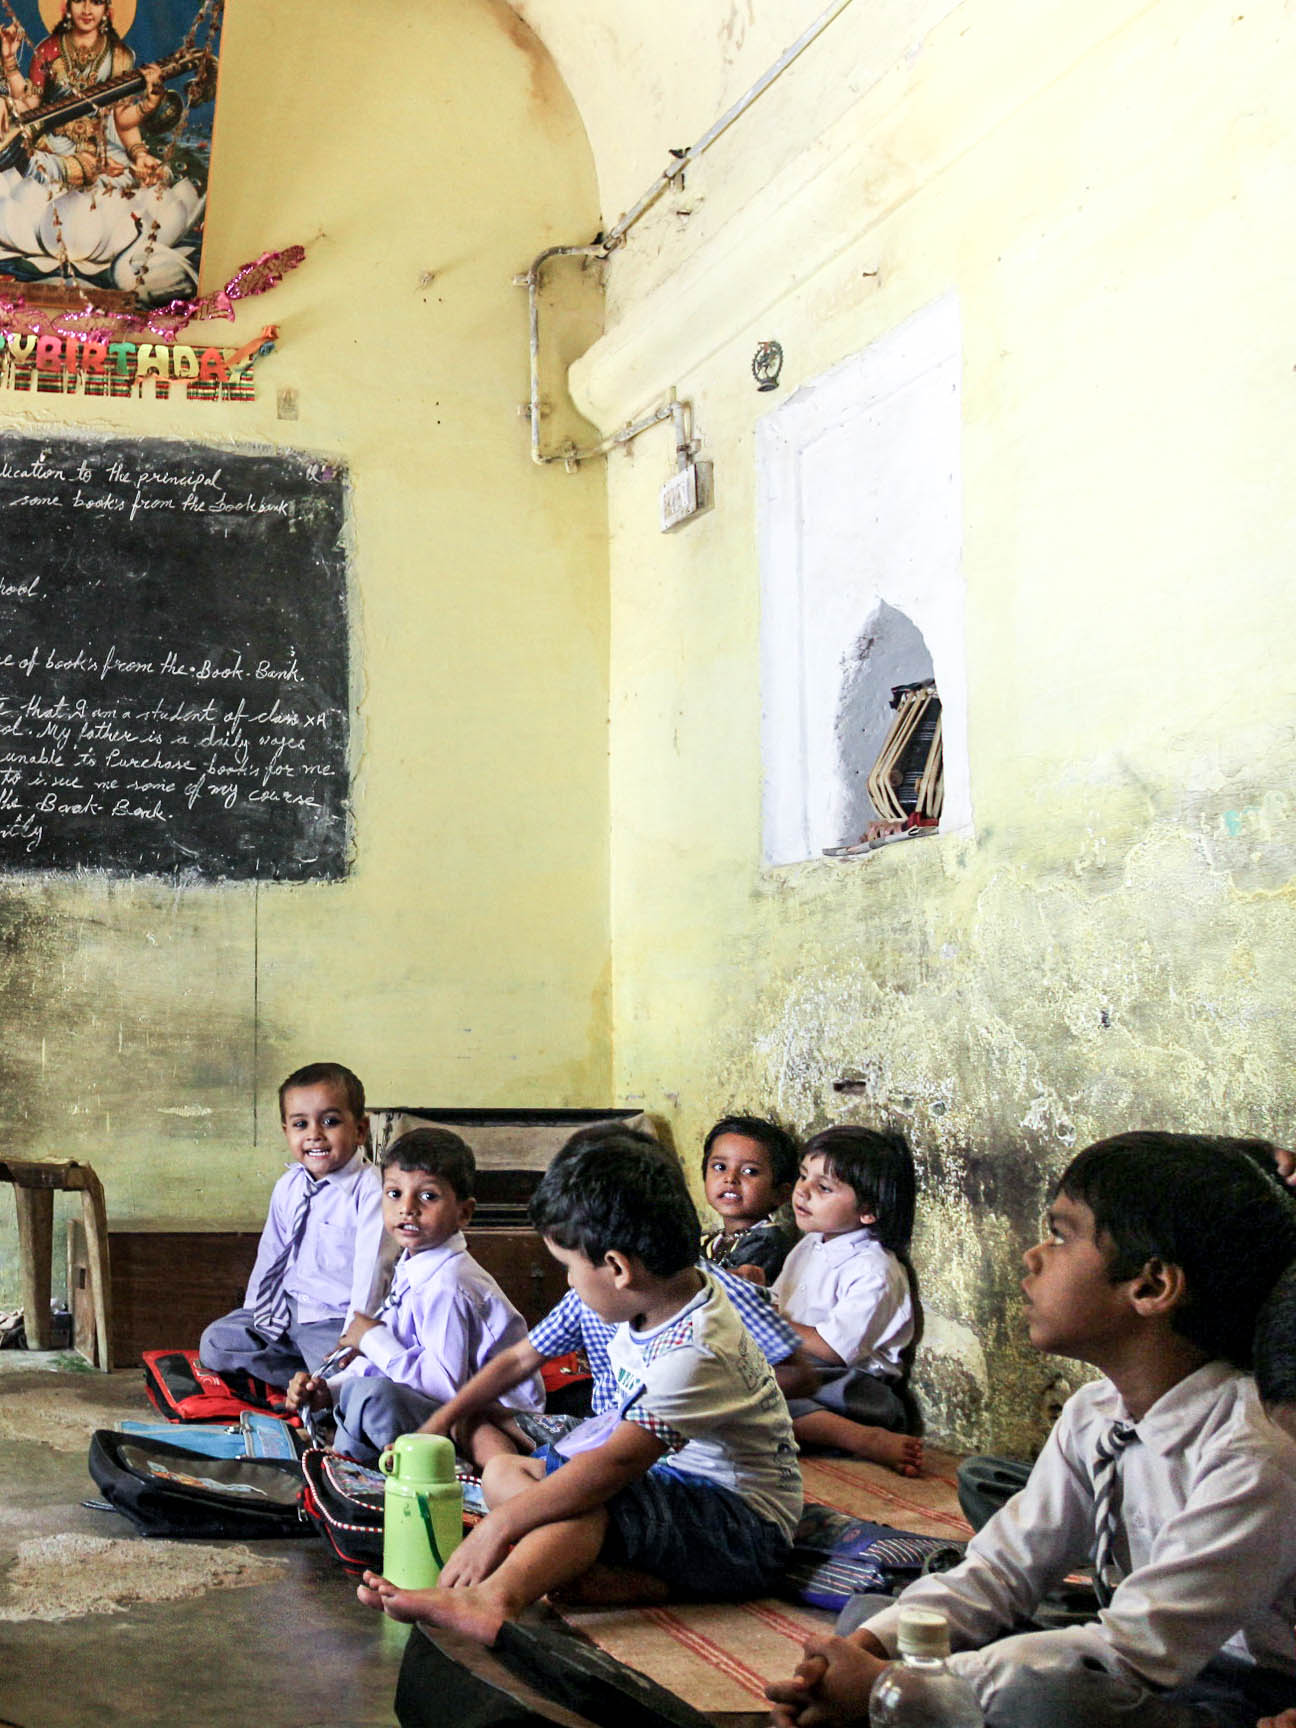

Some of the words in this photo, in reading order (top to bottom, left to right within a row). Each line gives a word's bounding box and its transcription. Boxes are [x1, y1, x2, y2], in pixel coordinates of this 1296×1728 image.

[77, 459, 93, 482] to
[105, 462, 130, 483] the
[136, 468, 222, 491] principal
[9, 495, 63, 507] some
[130, 490, 175, 521] from
[182, 493, 206, 512] the
[19, 647, 40, 677] of
[100, 646, 155, 681] from
[160, 651, 189, 676] the
[20, 695, 69, 719] that
[67, 700, 87, 719] I
[91, 706, 118, 719] am
[122, 711, 132, 719] a
[136, 698, 217, 722] student
[224, 698, 249, 733] of
[36, 722, 72, 750] My
[78, 722, 140, 743] father
[140, 731, 163, 744] is
[170, 735, 189, 745] a
[199, 725, 249, 764] daily
[259, 736, 306, 757] wages
[73, 747, 97, 767] to
[262, 756, 295, 786] for
[303, 764, 336, 775] me
[0, 767, 22, 786] to
[94, 779, 120, 790] me
[126, 780, 176, 792] some
[184, 773, 206, 810] of
[208, 784, 238, 809] my
[248, 790, 323, 807] course
